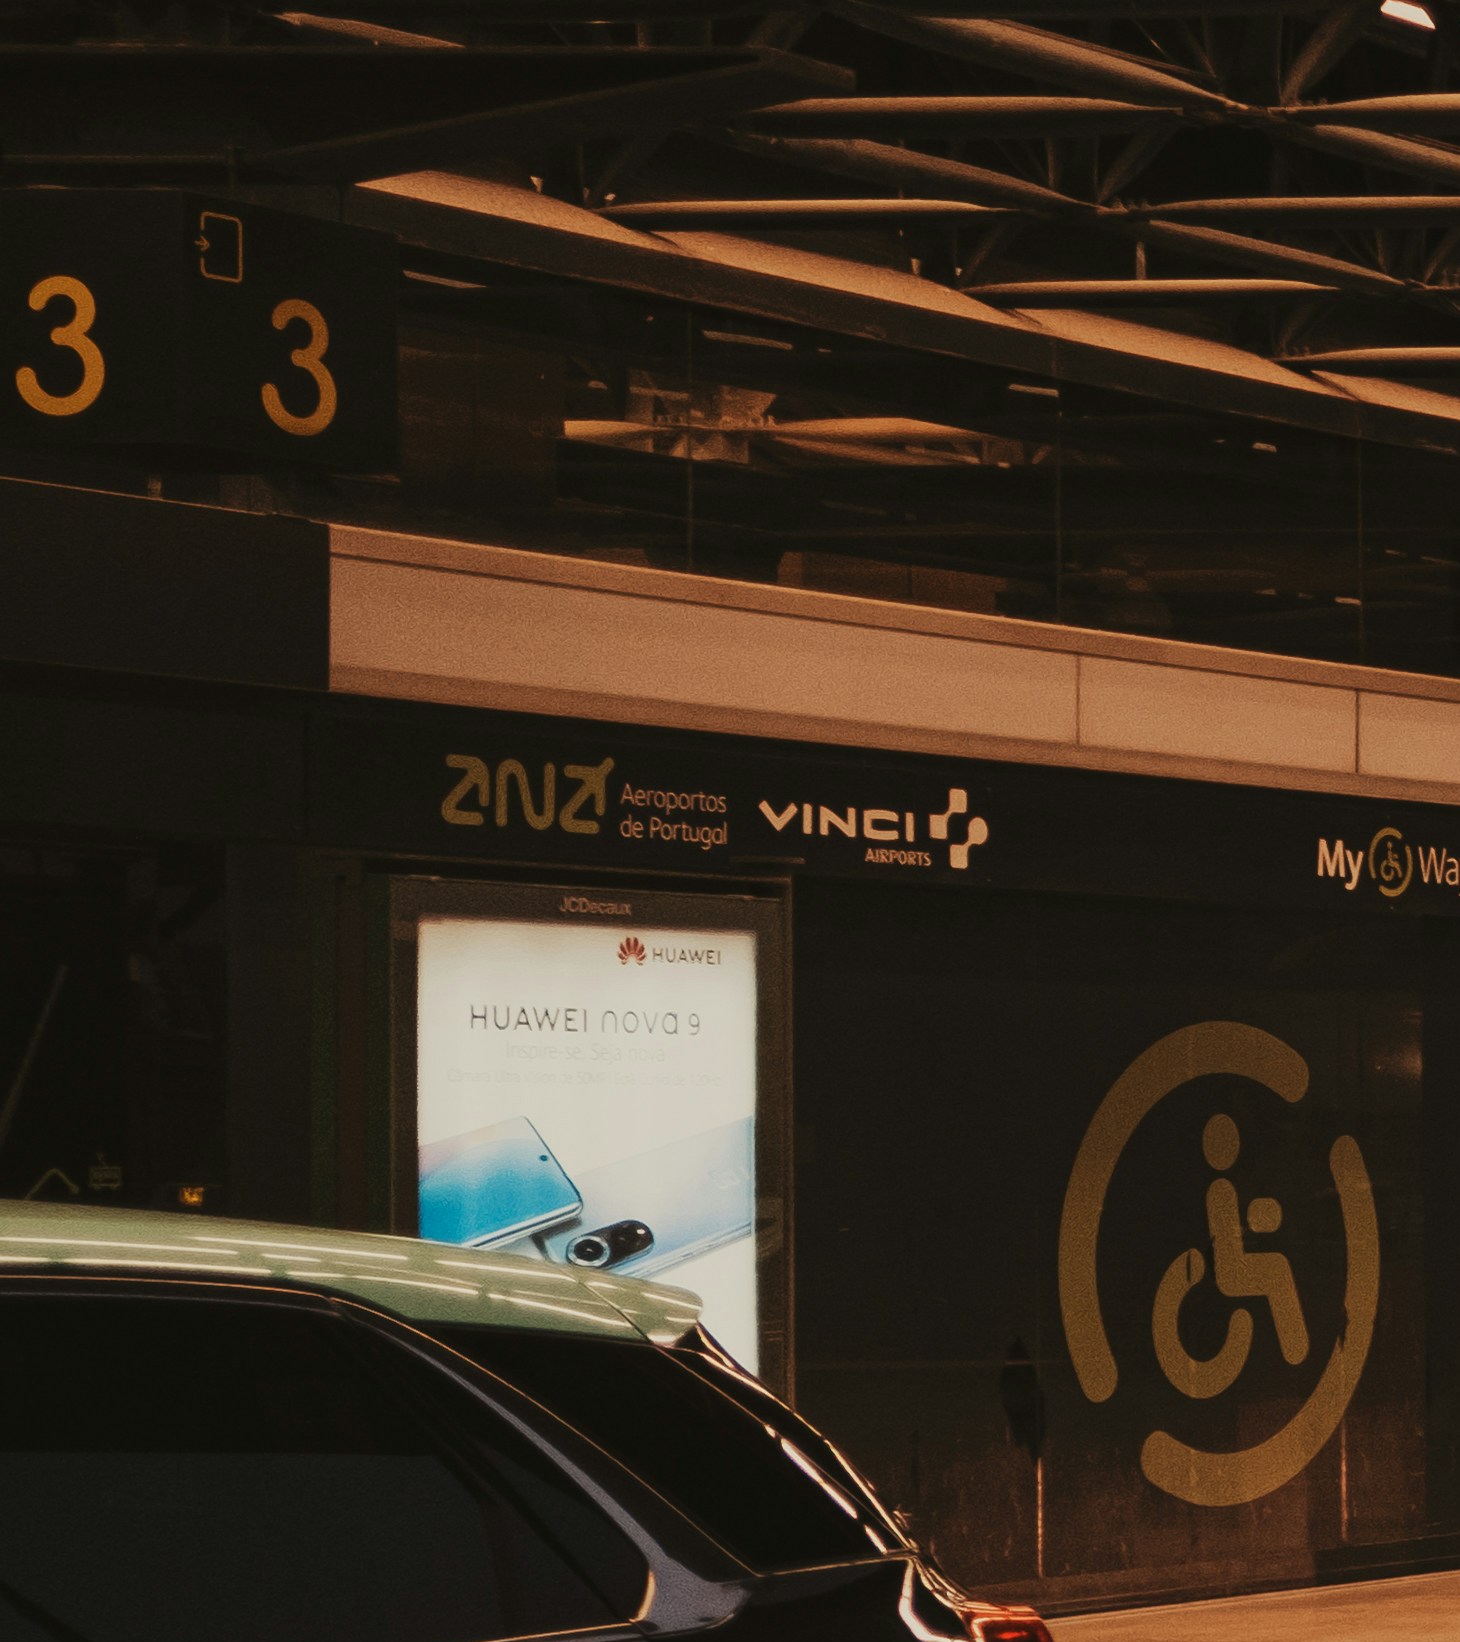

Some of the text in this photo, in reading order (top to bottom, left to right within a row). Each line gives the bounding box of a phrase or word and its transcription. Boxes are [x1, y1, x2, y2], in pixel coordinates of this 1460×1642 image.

[15, 275, 106, 417] 3
[261, 298, 338, 437] 3
[620, 784, 726, 813] Aeroportos
[620, 817, 728, 850] de Portugal
[759, 800, 915, 842] VINCI
[865, 848, 933, 867] AIRPORTS
[1317, 838, 1364, 891] My
[559, 897, 633, 917] JCDecaux
[652, 946, 722, 966] HUAWEI
[470, 1003, 702, 1036] HUAWEI nova 9
